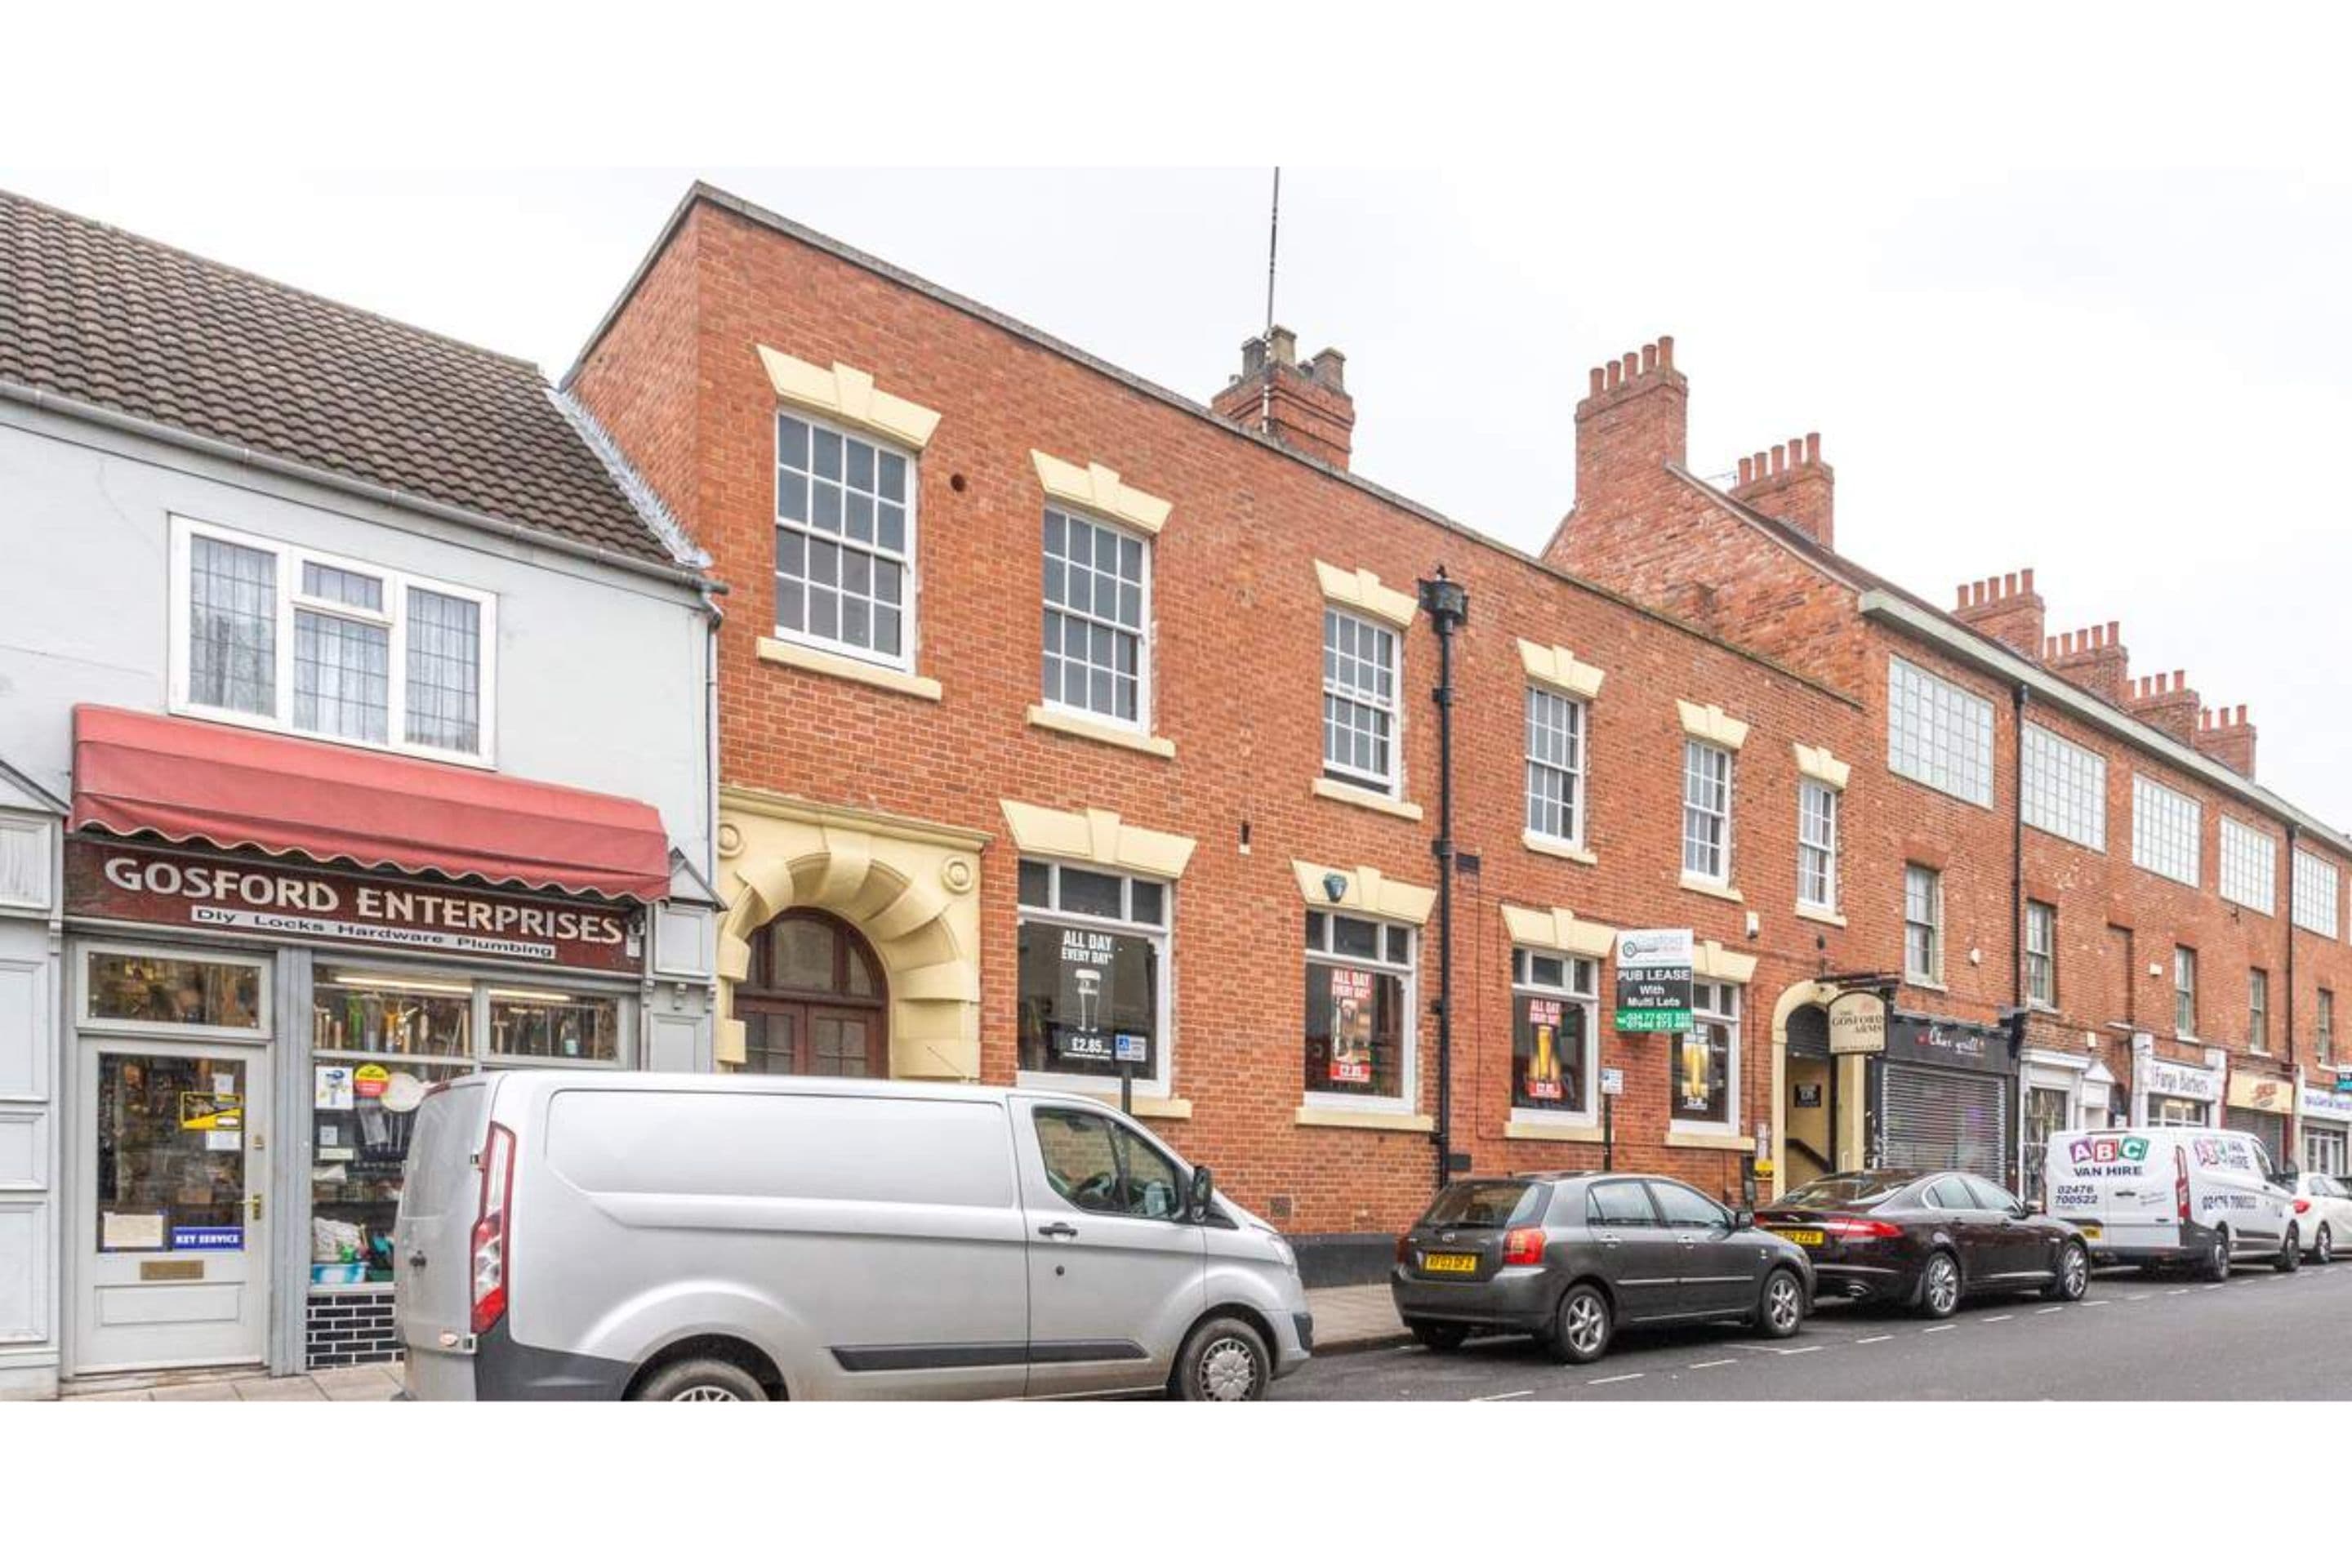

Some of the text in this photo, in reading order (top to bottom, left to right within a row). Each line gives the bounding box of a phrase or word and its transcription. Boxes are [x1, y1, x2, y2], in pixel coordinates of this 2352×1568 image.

[104, 857, 624, 944] GOSFORD ENTERPRISES
[254, 915, 326, 933] Locks
[337, 924, 445, 945] Hardware
[456, 935, 554, 957] Plumbing
[1063, 930, 1112, 951] ALL DAY
[1062, 947, 1089, 961] EVERY
[1619, 969, 1690, 981] PUB LEASE
[1639, 985, 1665, 995] With
[1832, 1015, 1882, 1027] GOSFORD
[2069, 1137, 2149, 1164] ABC
[2074, 1166, 2143, 1177] VAN HIRE
[2057, 1185, 2094, 1194] 02476
[2056, 1195, 2097, 1205] 700522
[176, 1234, 238, 1244] KEY SERVICE
